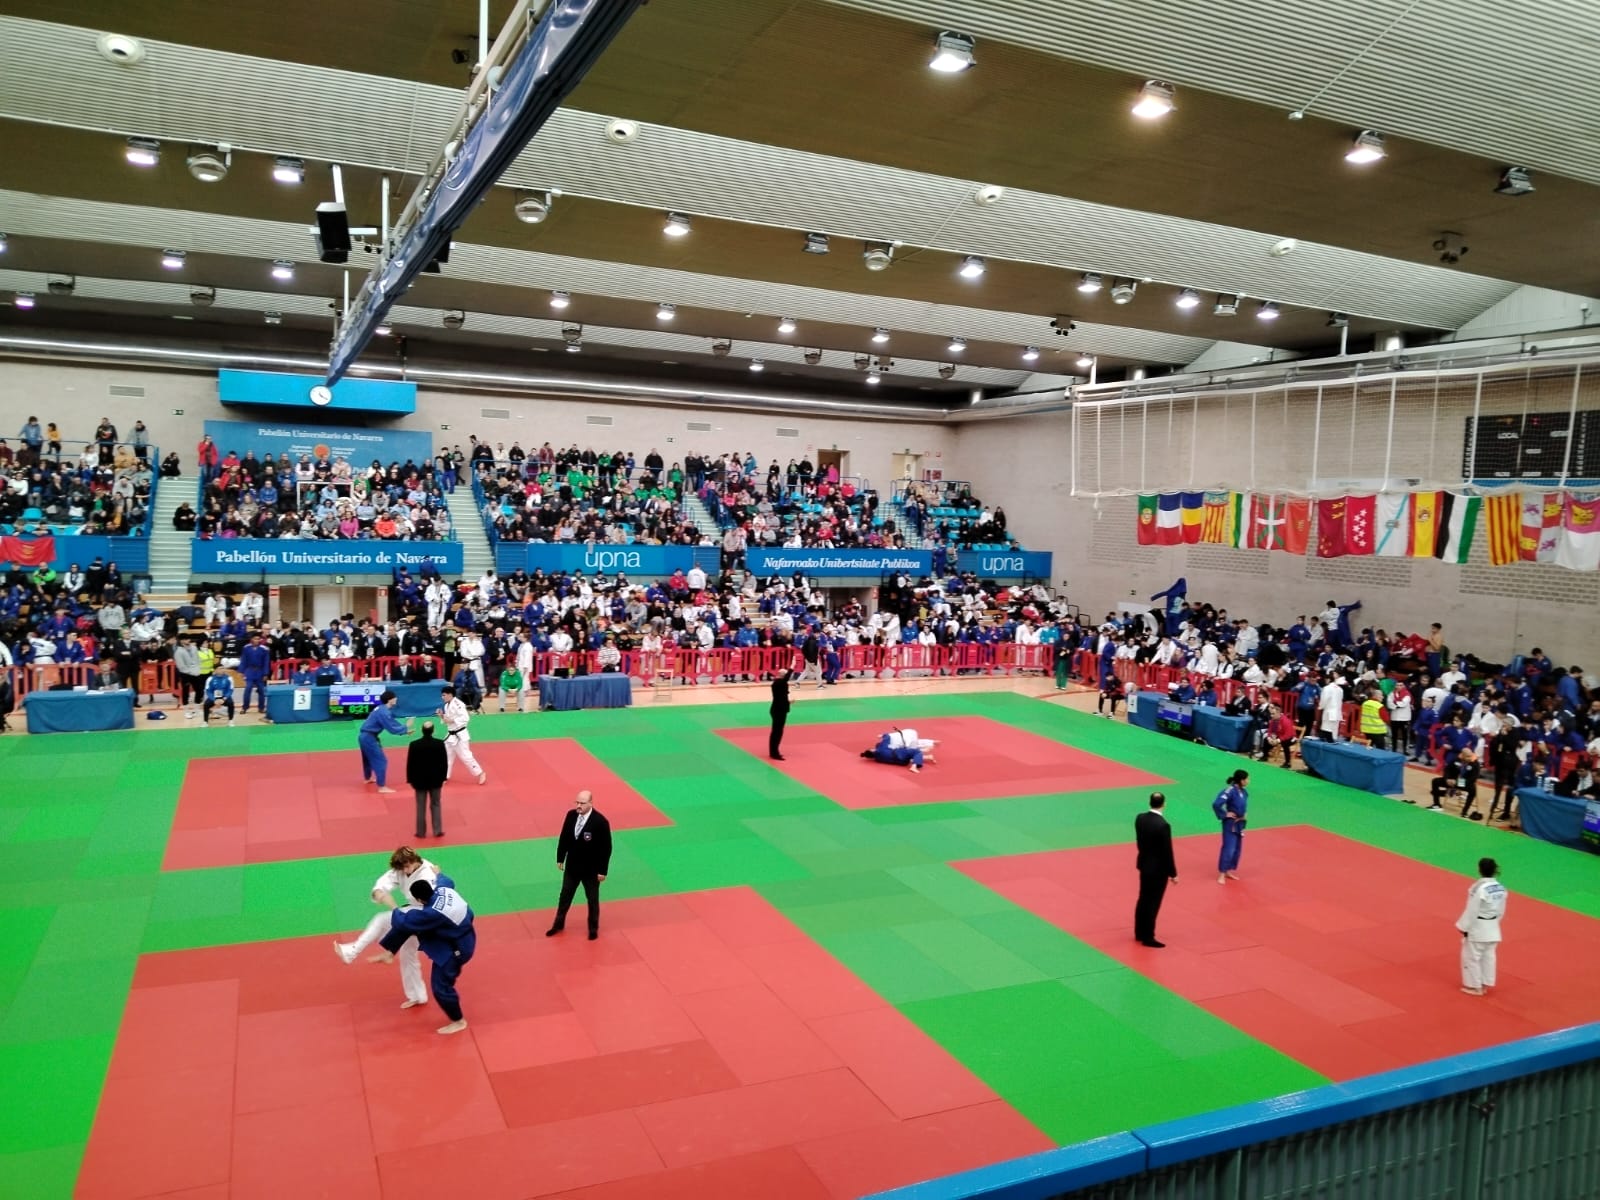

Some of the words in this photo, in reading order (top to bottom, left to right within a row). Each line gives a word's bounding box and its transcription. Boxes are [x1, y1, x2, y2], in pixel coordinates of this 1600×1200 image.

[216, 550, 277, 563] Pabellón
[282, 551, 372, 564] Universitario
[375, 552, 392, 564] de
[395, 552, 448, 564] Navrra
[585, 551, 641, 571] upna
[763, 557, 819, 570] Nafarroako
[819, 558, 880, 568] Unibertsitate
[880, 558, 920, 569] Publikoa
[982, 557, 1024, 575] upna
[297, 694, 306, 705] 3
